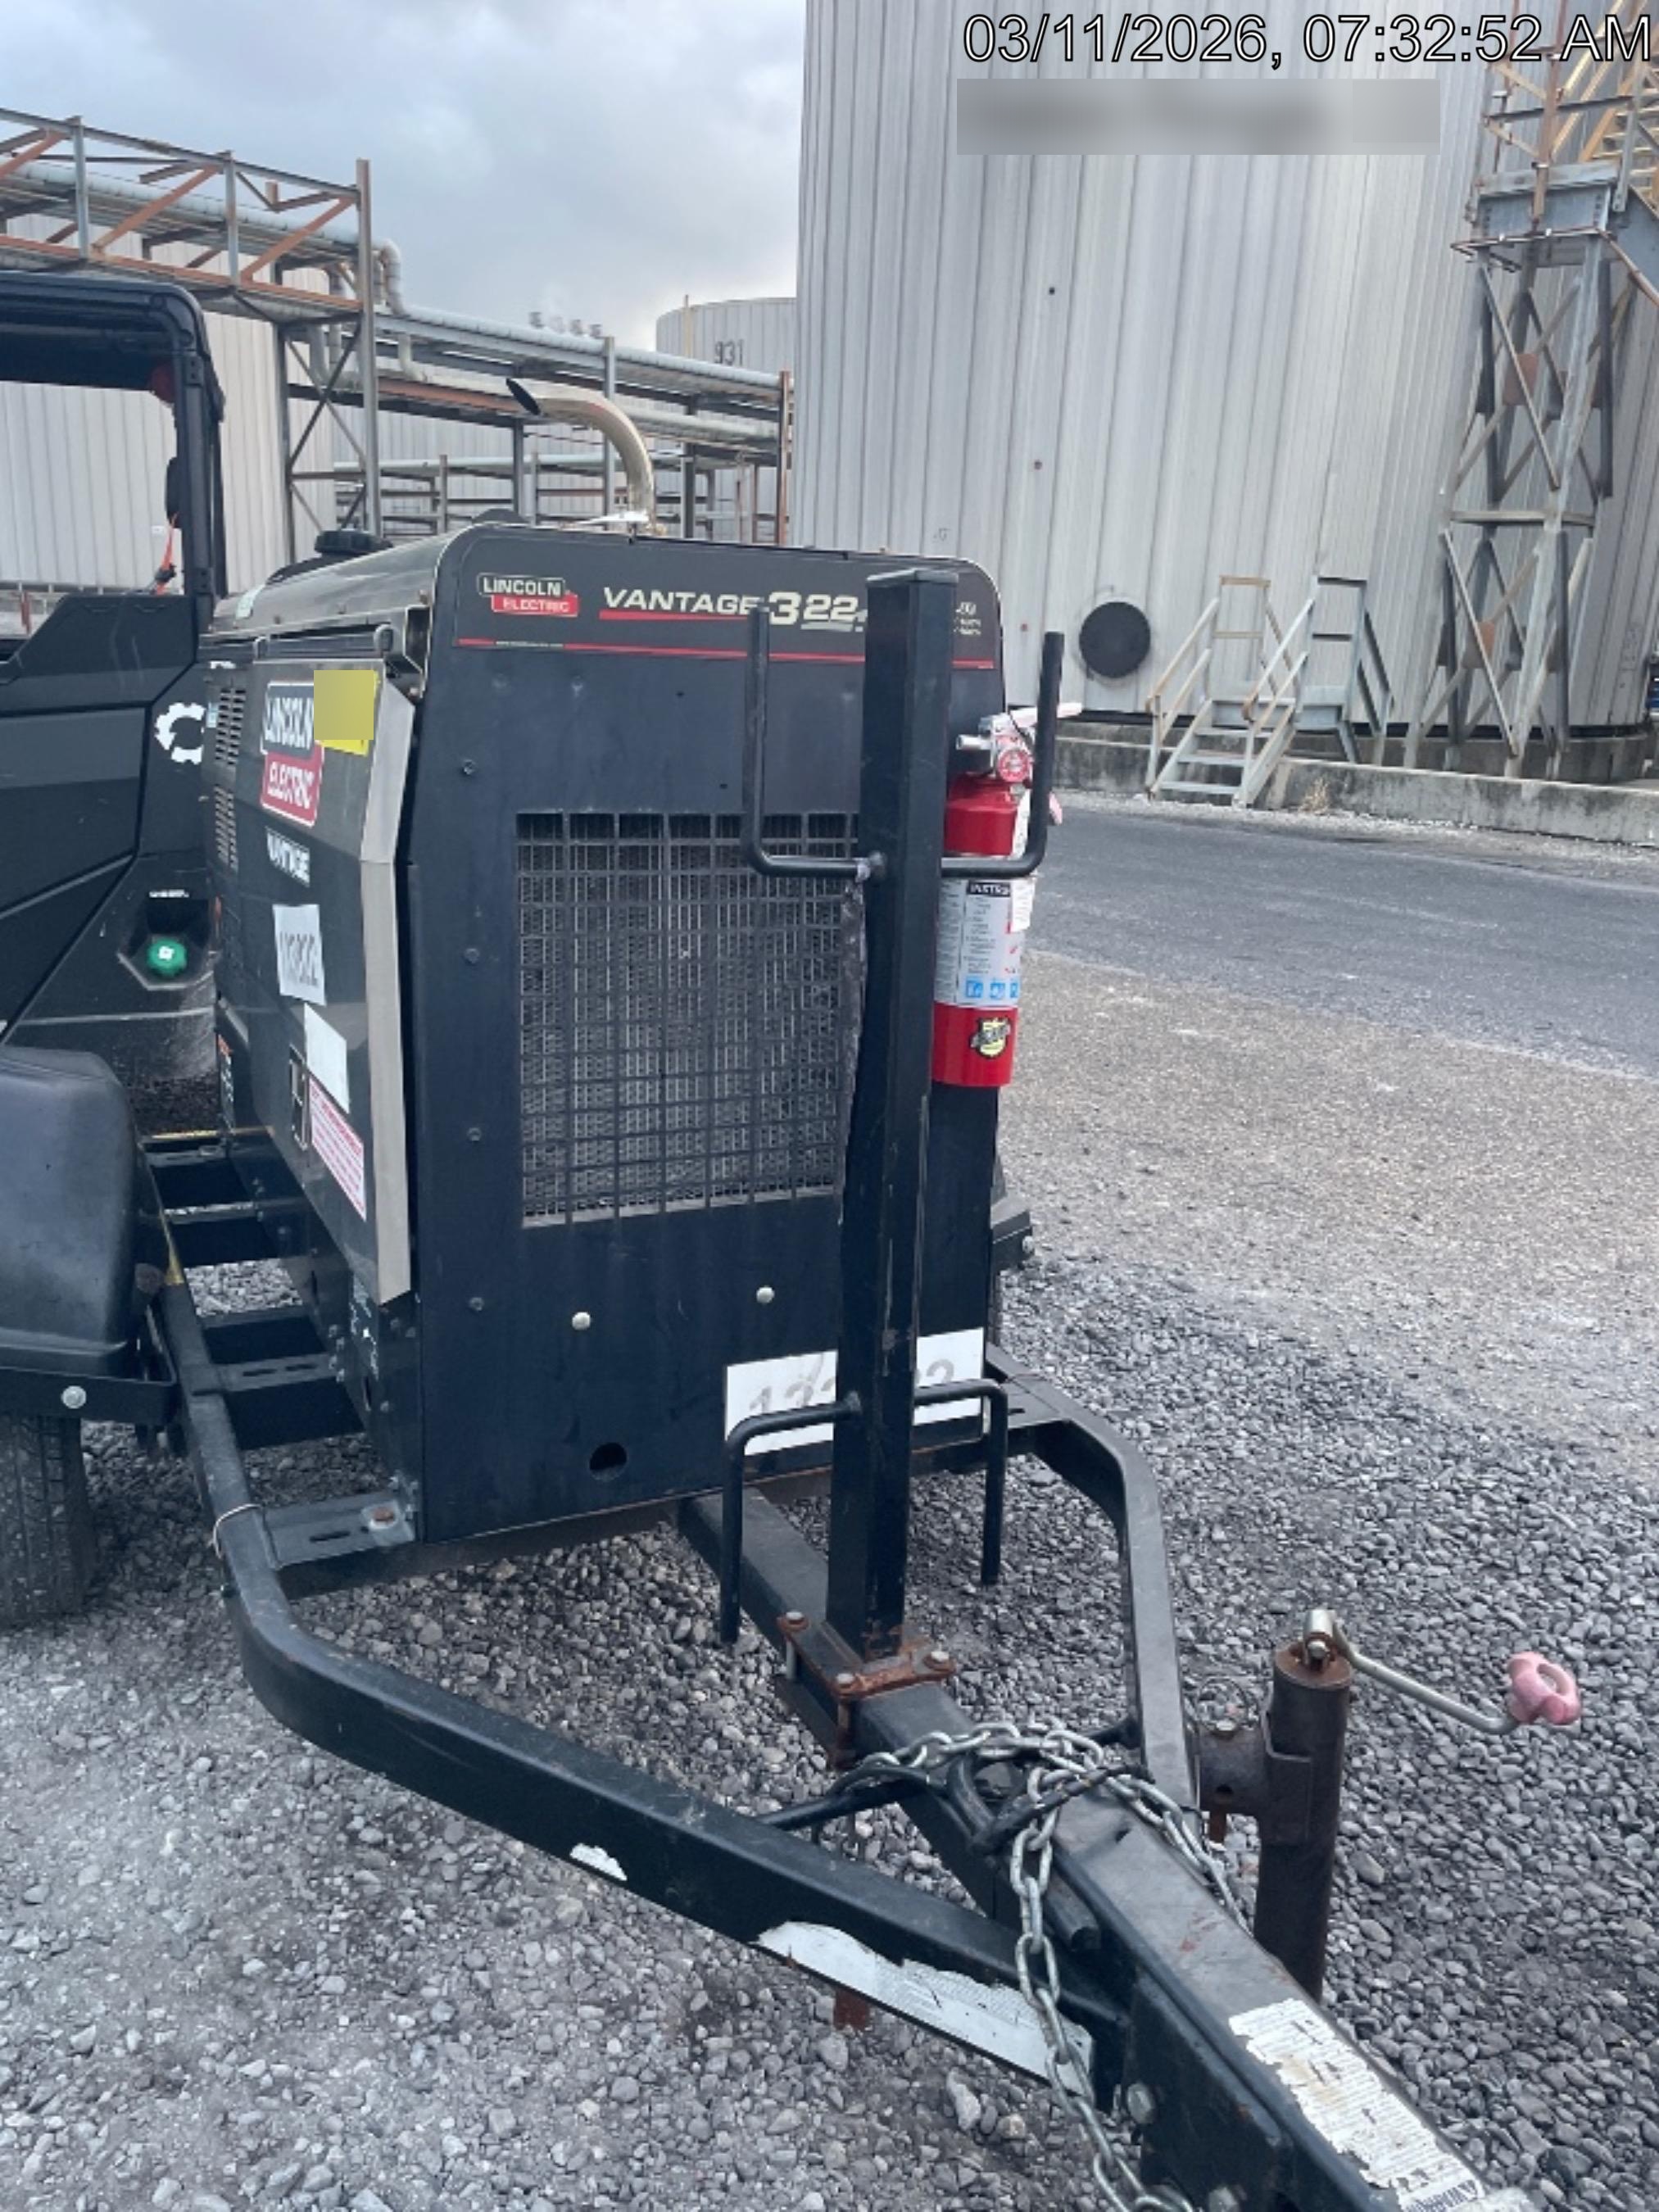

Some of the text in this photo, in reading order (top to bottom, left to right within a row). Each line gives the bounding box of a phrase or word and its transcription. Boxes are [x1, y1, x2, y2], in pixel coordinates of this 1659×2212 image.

[714, 338, 743, 366] 931
[482, 576, 562, 597] LINCOLN
[502, 597, 571, 613] ELECTRIC
[603, 587, 764, 616] VANTAGE
